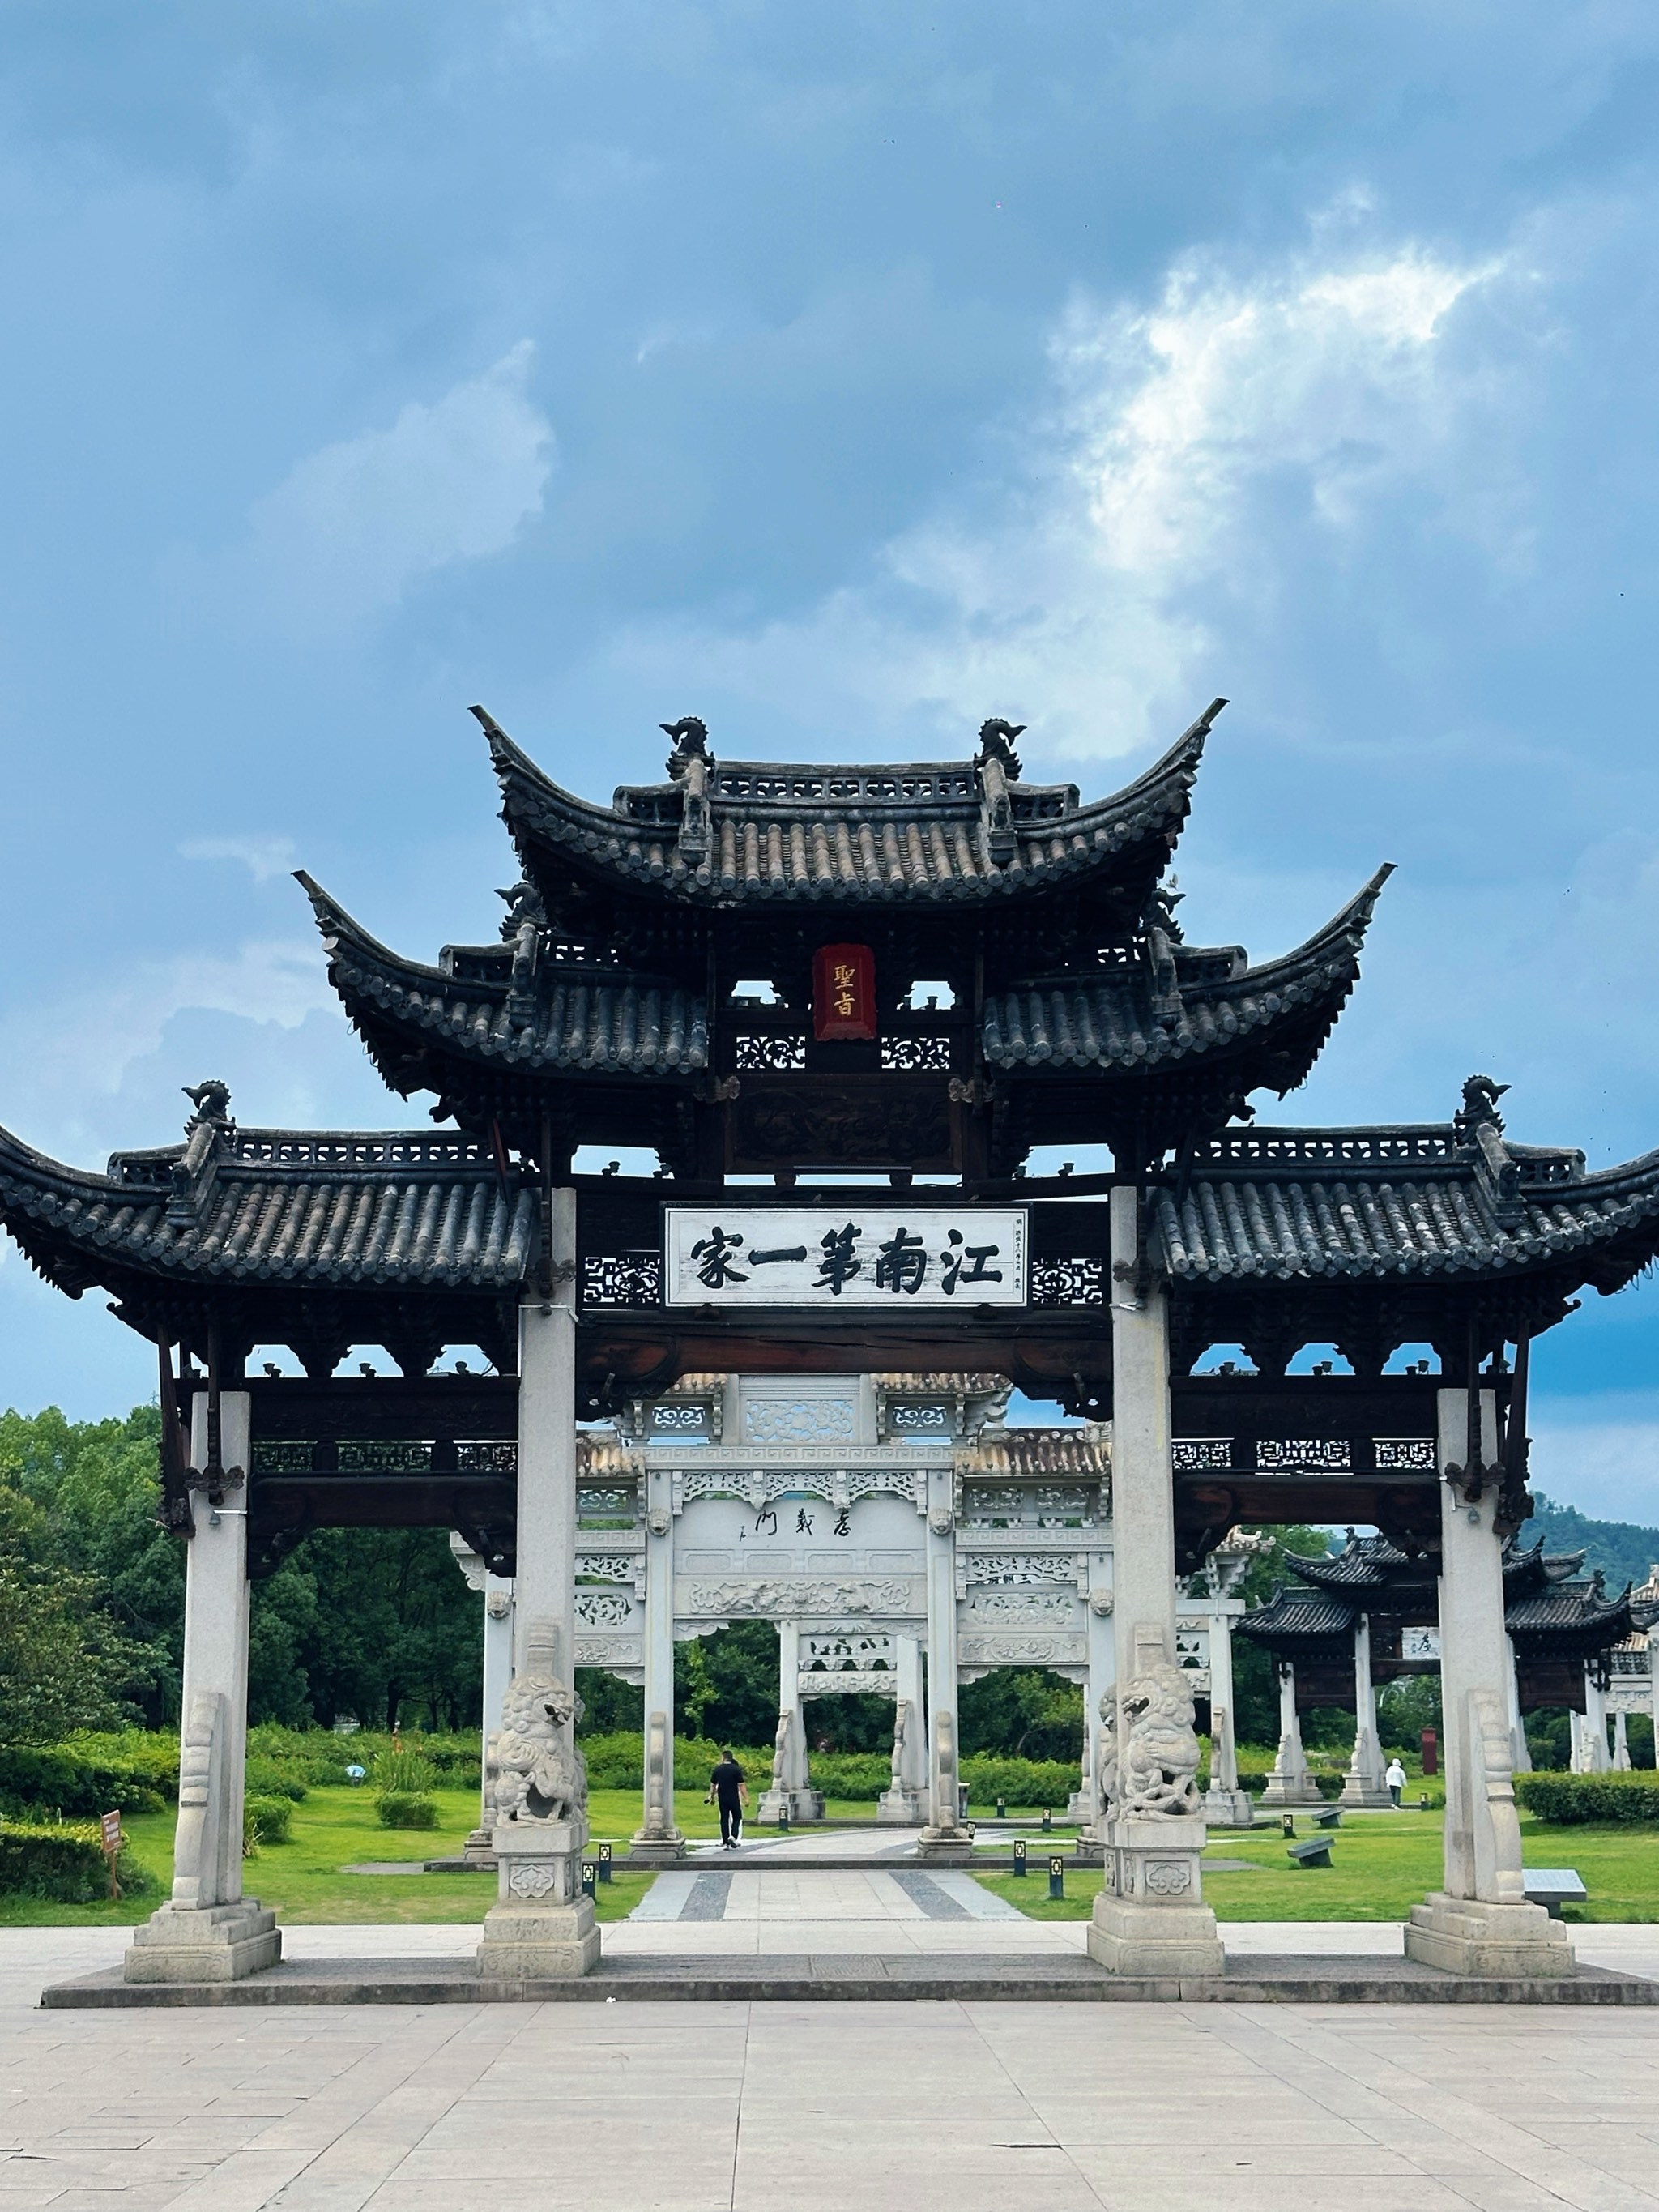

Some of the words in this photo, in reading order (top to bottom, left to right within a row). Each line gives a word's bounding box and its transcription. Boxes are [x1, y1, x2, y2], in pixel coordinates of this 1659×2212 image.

[834, 965, 855, 1016] 聖旨
[691, 1219, 1003, 1296] 江南第一家
